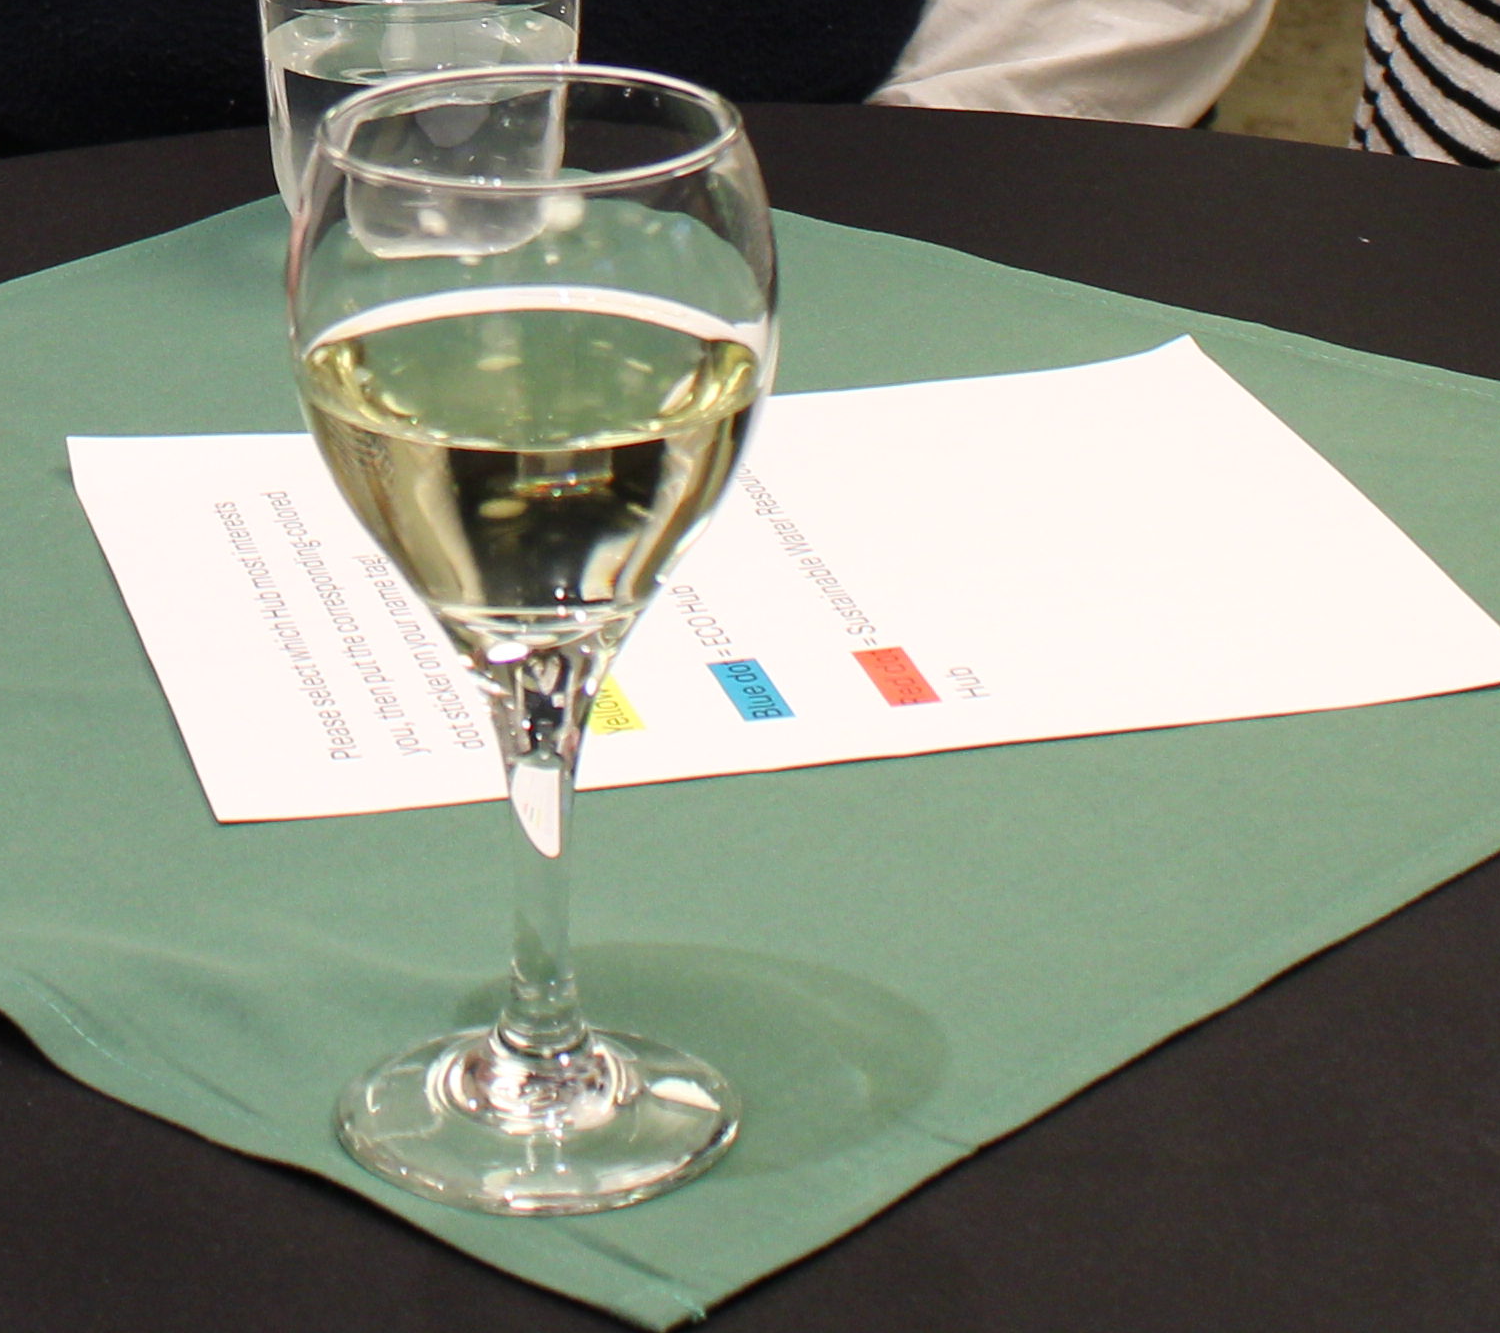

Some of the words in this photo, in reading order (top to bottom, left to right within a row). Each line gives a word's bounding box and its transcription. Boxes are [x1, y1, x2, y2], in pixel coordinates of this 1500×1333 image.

[214, 500, 258, 555] interests
[768, 517, 813, 557] Water
[237, 556, 277, 590] most
[260, 490, 360, 633] corresponding-colored
[256, 590, 291, 620] Hub
[374, 579, 412, 617] name
[668, 584, 708, 615] Hub
[798, 556, 877, 635] Sustainable
[268, 620, 313, 663] which
[342, 634, 374, 660] the
[393, 620, 438, 651] your
[687, 615, 732, 647] ECO
[352, 659, 394, 684] put
[412, 650, 441, 670] on
[723, 660, 758, 683] dot
[291, 662, 335, 707] select
[422, 672, 470, 720] sticker
[946, 666, 991, 699] Hub
[369, 686, 405, 721] then
[742, 685, 783, 719] Blue
[318, 709, 362, 761] Please
[390, 721, 432, 756] you,
[448, 721, 485, 750] dot
